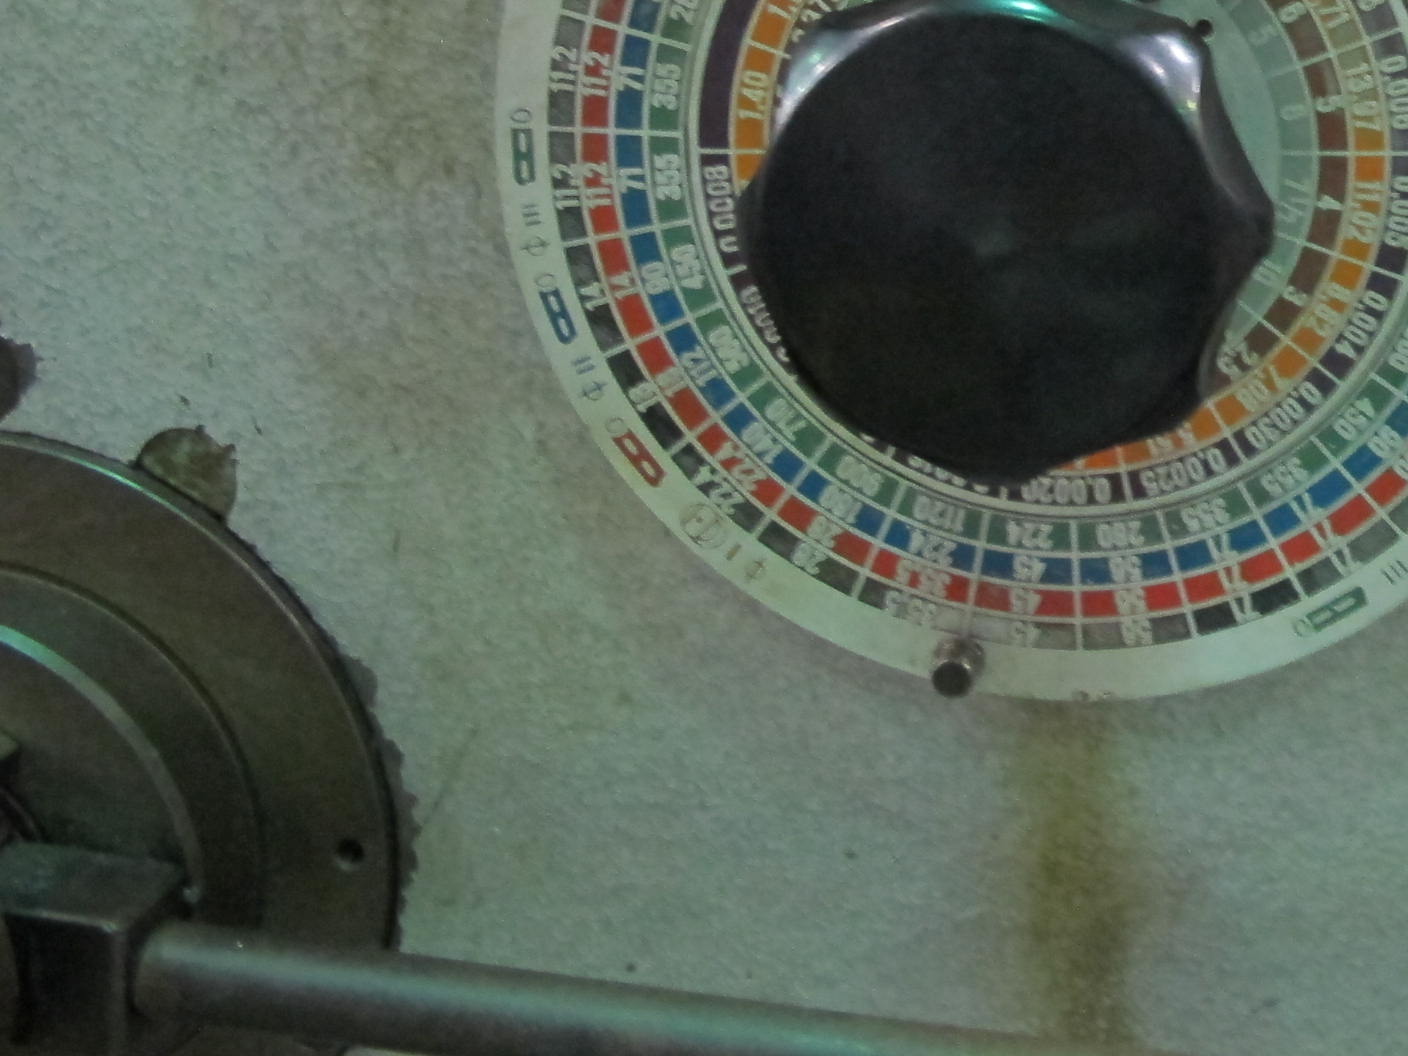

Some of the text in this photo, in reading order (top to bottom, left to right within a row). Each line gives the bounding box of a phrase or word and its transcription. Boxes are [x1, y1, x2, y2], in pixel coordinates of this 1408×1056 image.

[1276, 0, 1306, 24] 6
[617, 65, 645, 92] 71
[652, 61, 682, 110] 355
[738, 70, 770, 119] 1,40
[1342, 179, 1385, 243] 11,02
[618, 166, 647, 193] 71
[652, 153, 682, 202] 355
[1316, 194, 1343, 213] 4
[670, 242, 706, 293] 450
[578, 280, 607, 311] 14
[608, 270, 637, 300] 14
[1282, 284, 1310, 309] 3
[1333, 290, 1389, 359] 0,004
[680, 344, 718, 386] 112
[763, 396, 806, 439] 710
[1334, 397, 1378, 441] 450
[1260, 456, 1308, 498] 355
[1180, 496, 1230, 534] 355
[1290, 491, 1319, 522] 71
[1004, 519, 1054, 547] 224
[1207, 532, 1235, 562] 71
[1310, 517, 1340, 547] 71
[1330, 546, 1360, 577] 71
[1218, 562, 1247, 593] 71
[1007, 587, 1041, 615] 45
[1230, 595, 1260, 624] 71
